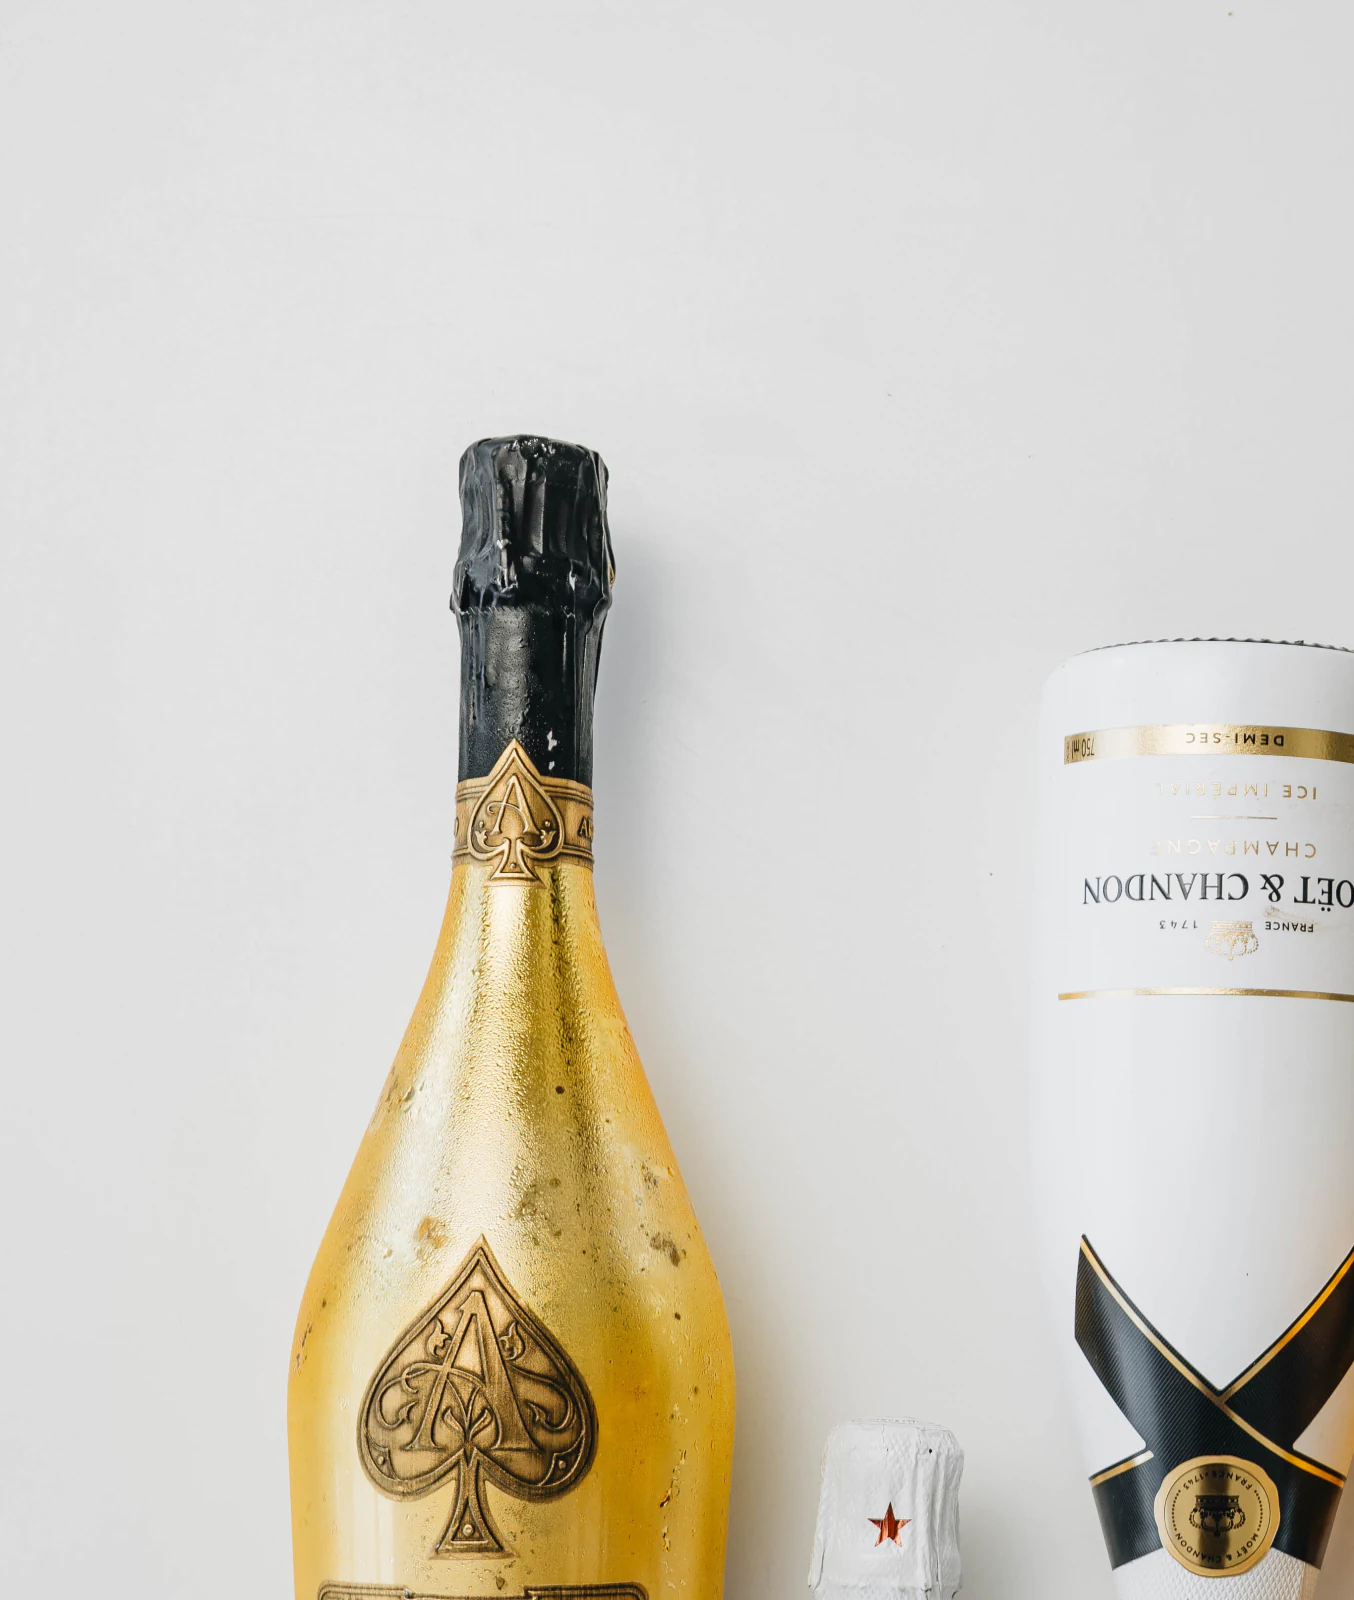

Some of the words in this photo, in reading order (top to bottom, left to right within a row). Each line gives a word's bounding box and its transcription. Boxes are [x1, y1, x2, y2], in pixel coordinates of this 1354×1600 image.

[1186, 732, 1285, 747] DEMI-SEC
[1282, 784, 1317, 800] ICE
[1083, 872, 1250, 905] CHANDON
[1259, 873, 1285, 902] &
[1158, 919, 1198, 931] 1743
[1265, 920, 1315, 934] FRANCE
[1183, 1470, 1205, 1491] 1743
[1211, 1469, 1253, 1491] FRANCE
[1175, 1532, 1222, 1564] CHANDON
